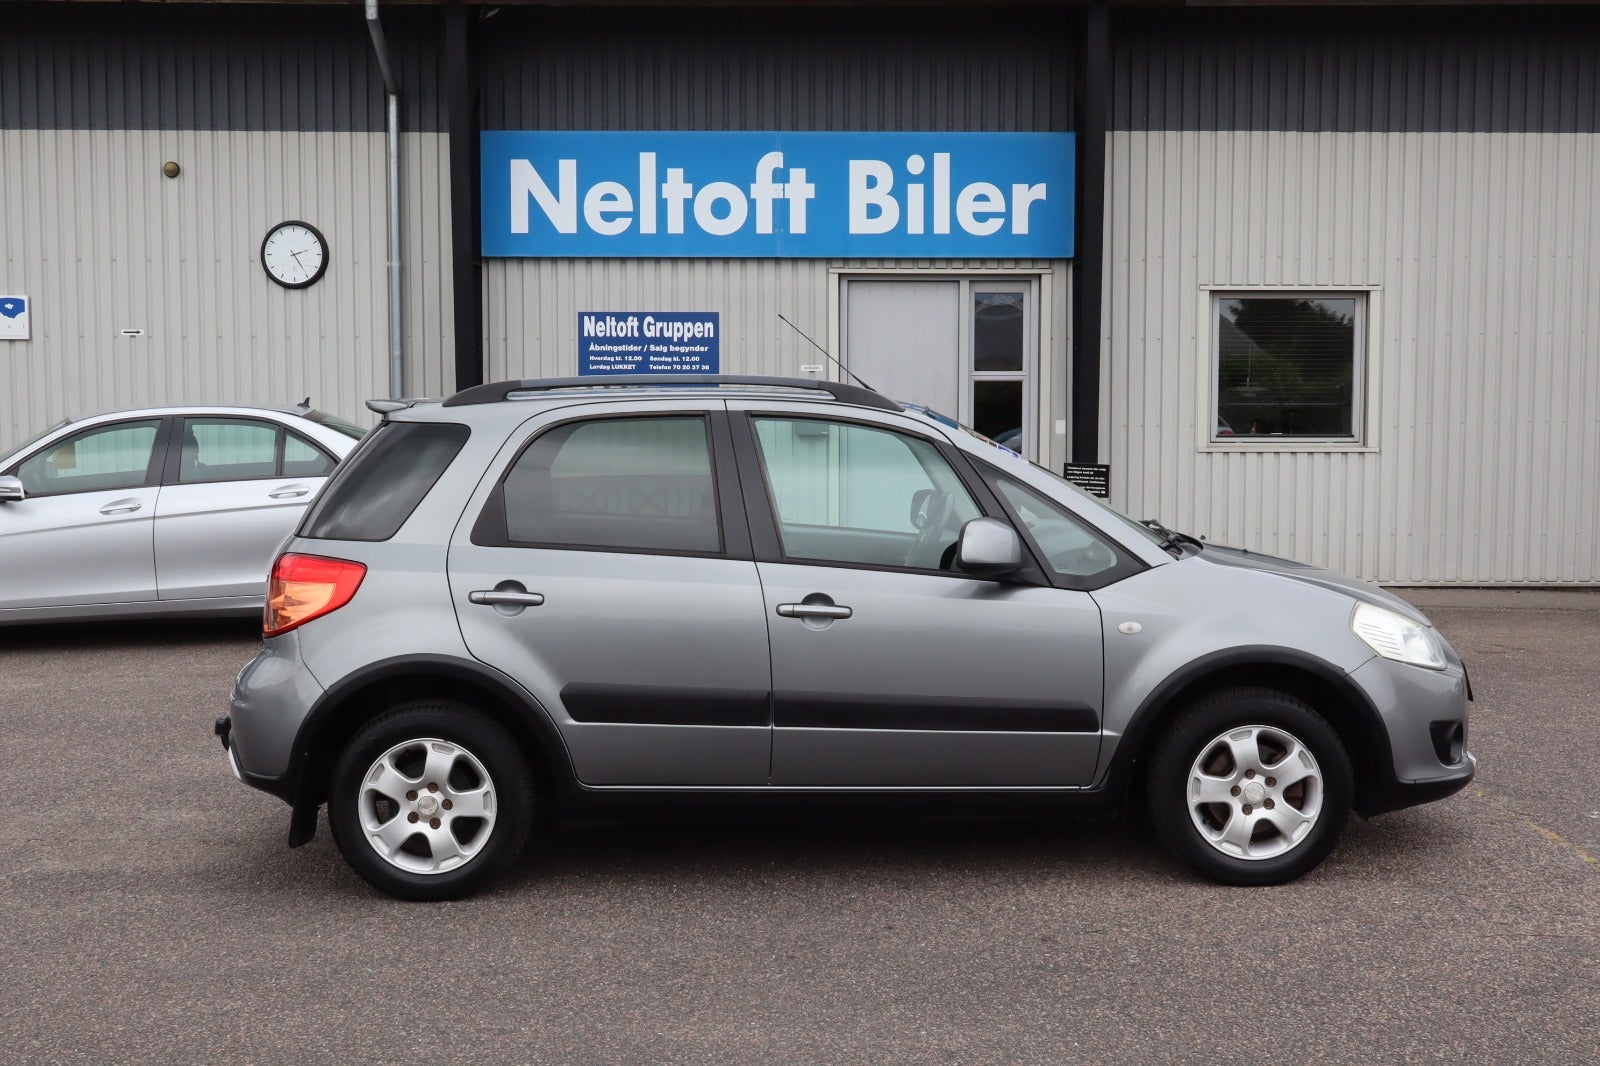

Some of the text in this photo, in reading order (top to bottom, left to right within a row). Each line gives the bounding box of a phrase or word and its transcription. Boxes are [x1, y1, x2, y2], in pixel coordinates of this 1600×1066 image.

[510, 151, 1047, 236] Neltoft Biler
[583, 315, 714, 342] Neltoft Gruppen
[589, 342, 709, 353] Åbningstider / Salg begynder
